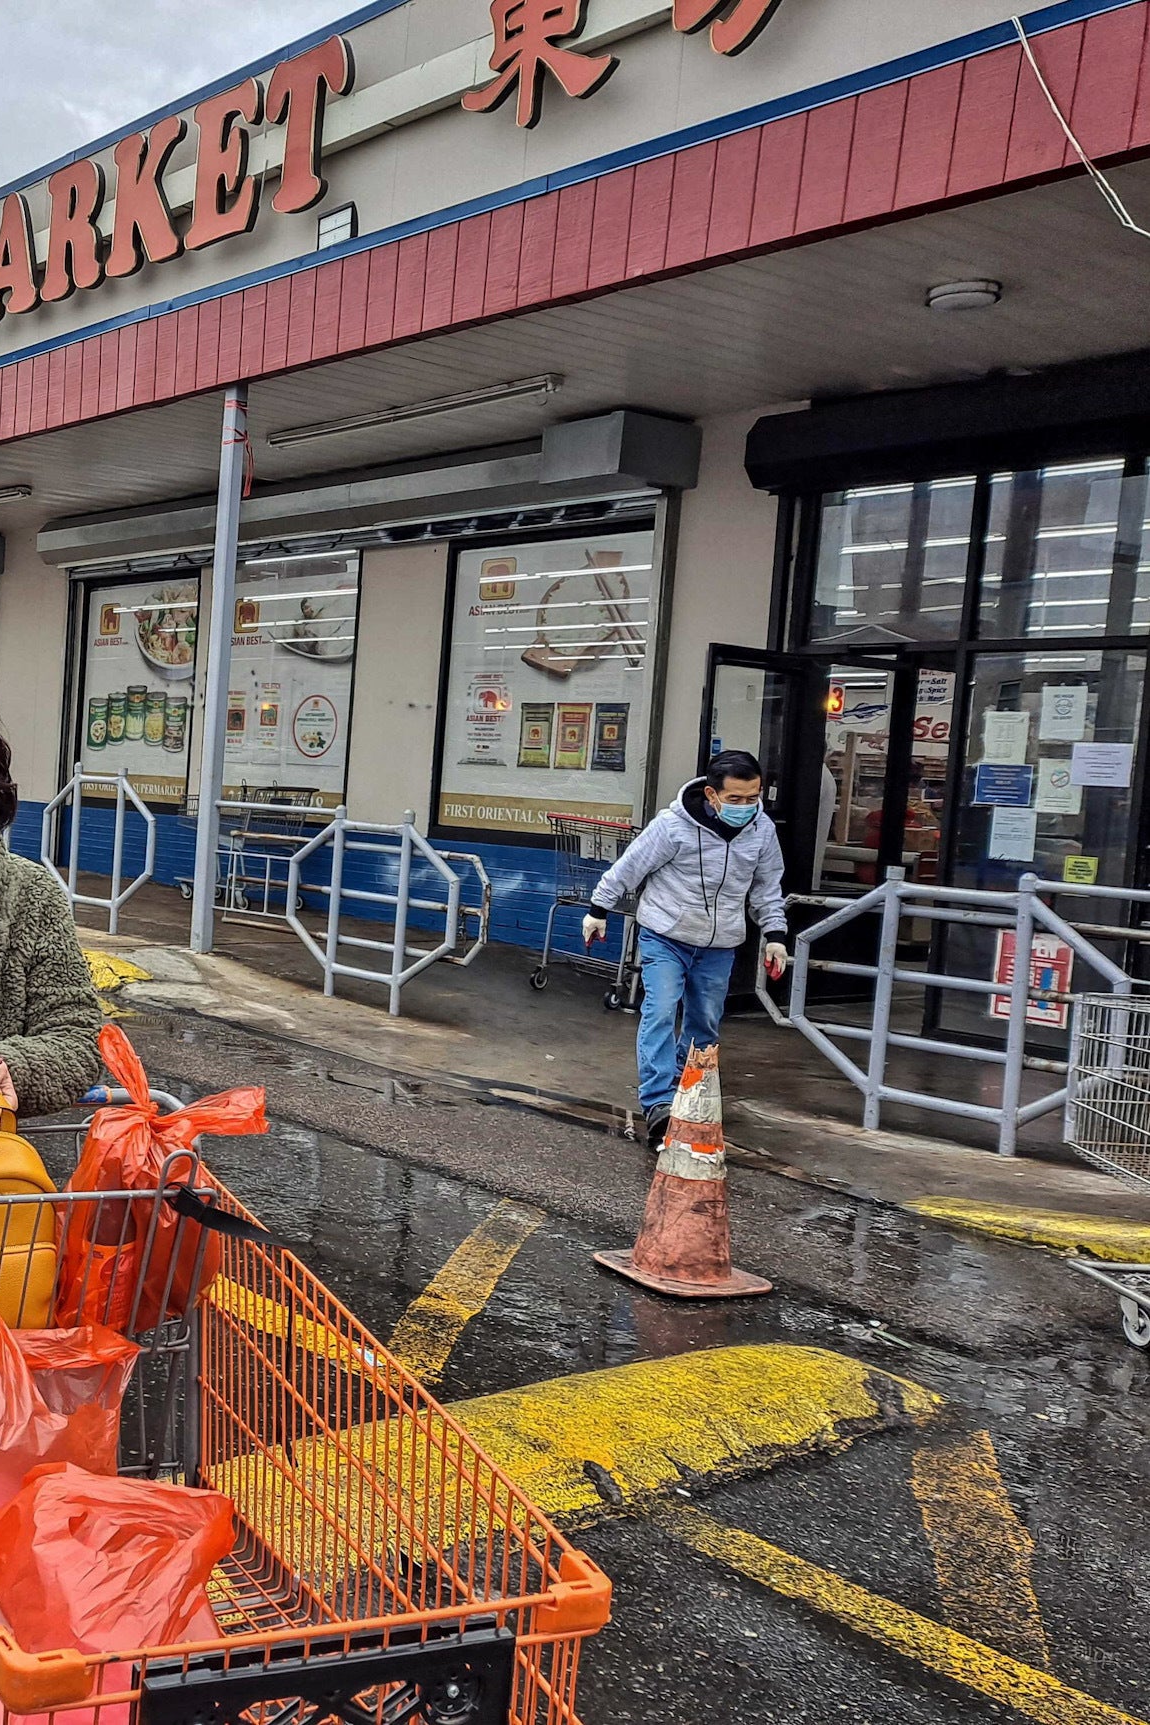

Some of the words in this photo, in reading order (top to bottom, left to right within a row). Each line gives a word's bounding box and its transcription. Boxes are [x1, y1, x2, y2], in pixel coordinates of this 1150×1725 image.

[93, 638, 109, 647] ASIAN
[109, 637, 122, 646] BEST
[231, 637, 245, 646] SIAN
[246, 636, 262, 646] BEST
[132, 783, 184, 796] SUPERMARKET
[444, 803, 476, 818] FIRST
[477, 806, 535, 823] ORIENTAL
